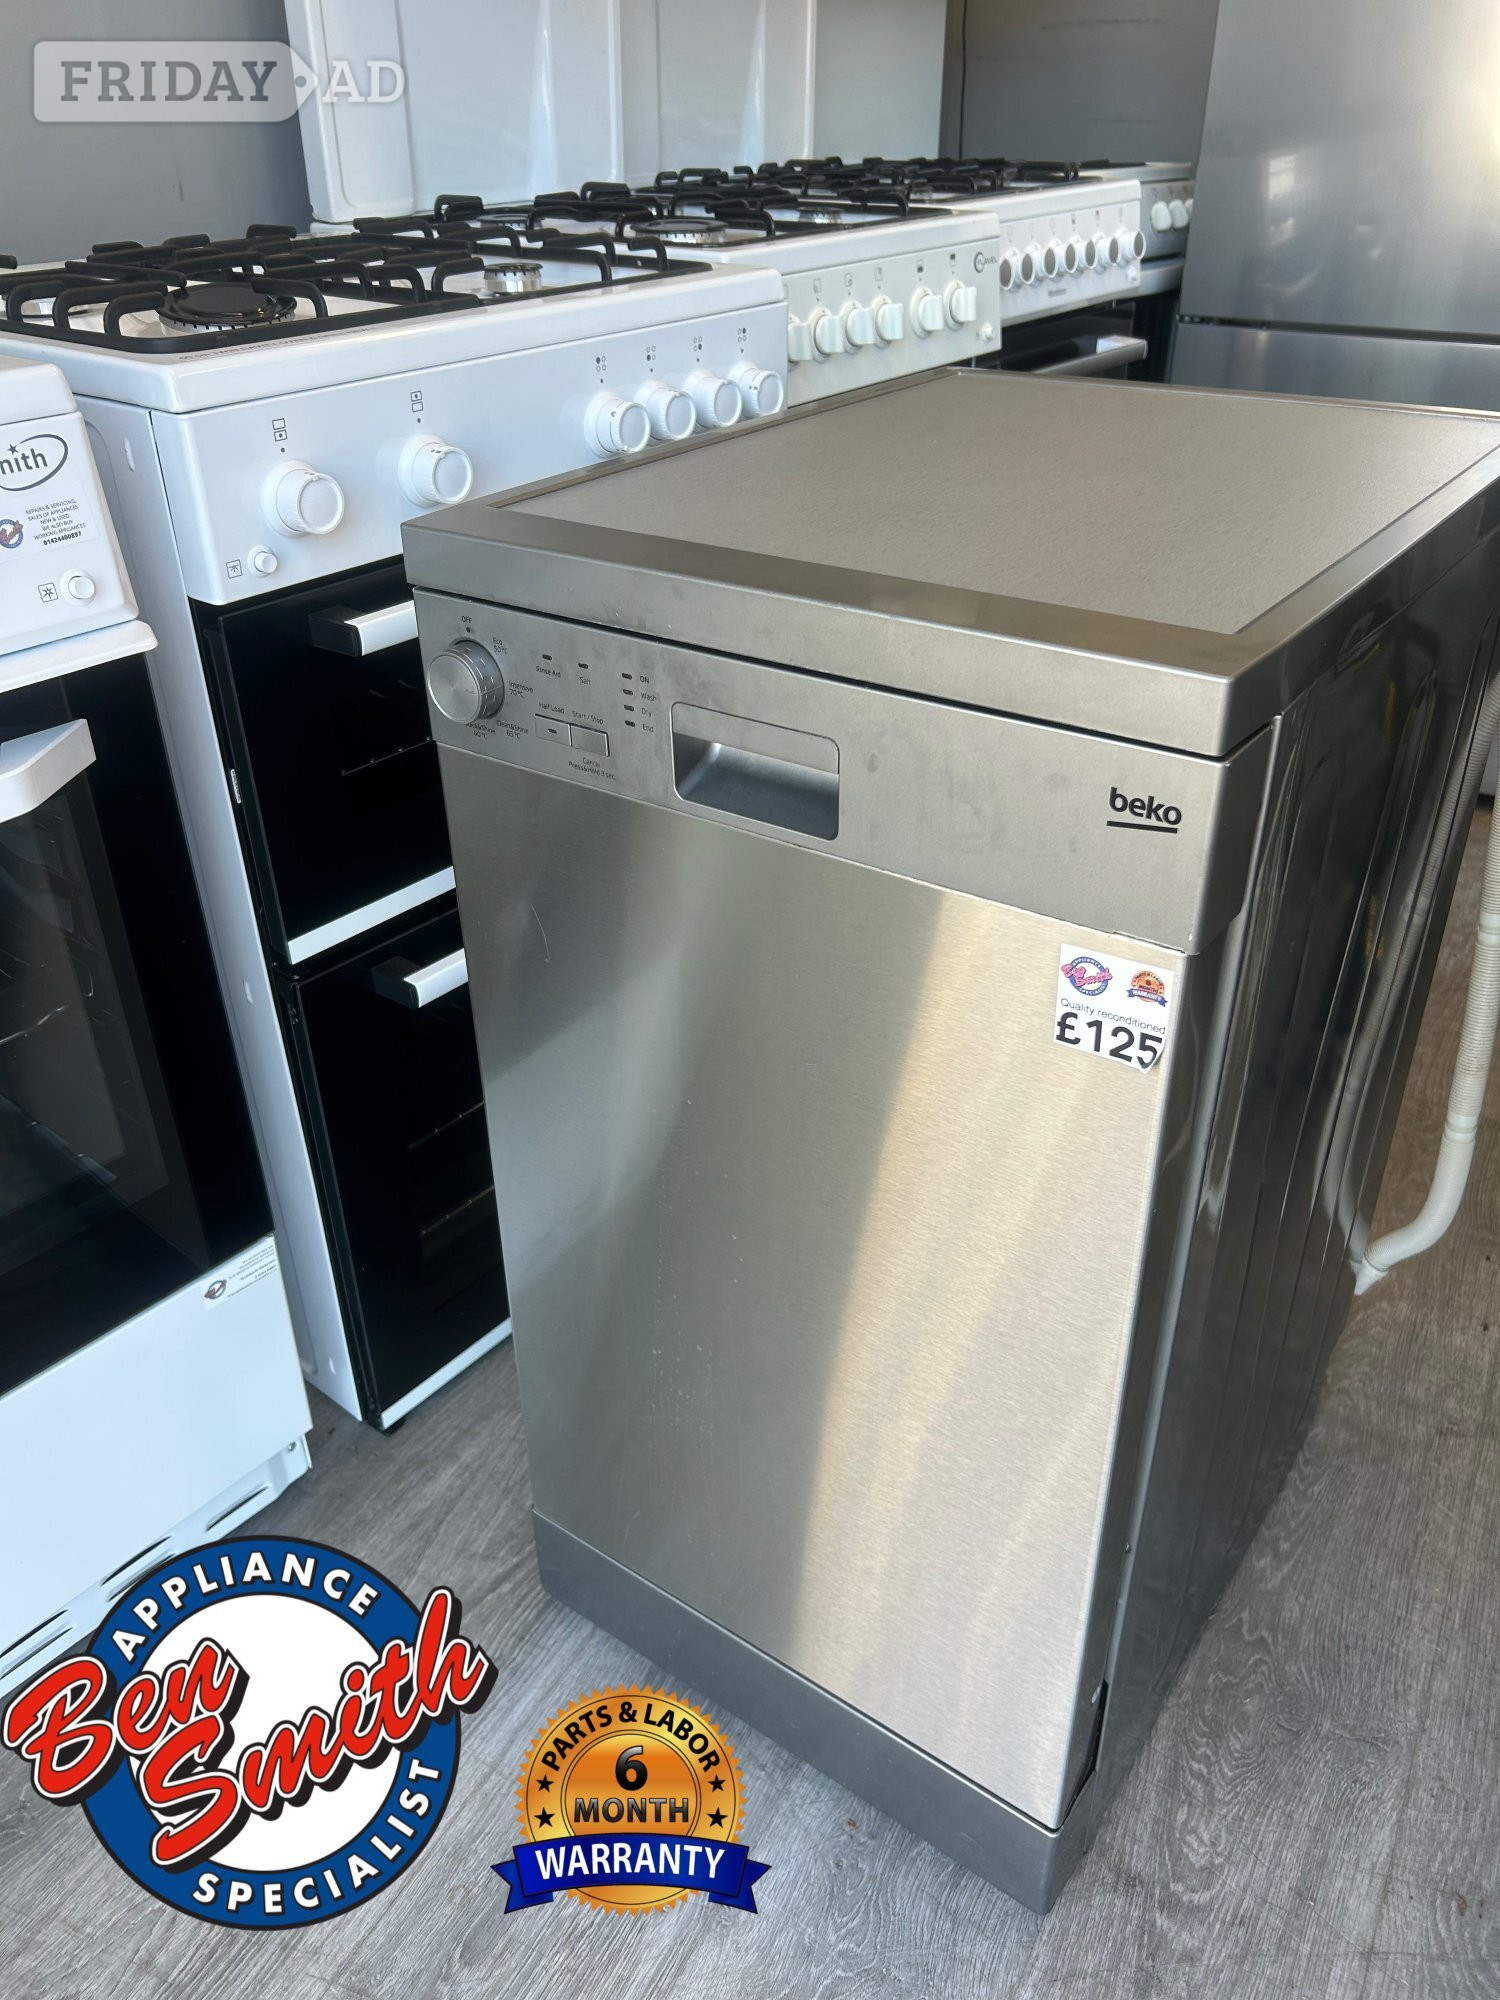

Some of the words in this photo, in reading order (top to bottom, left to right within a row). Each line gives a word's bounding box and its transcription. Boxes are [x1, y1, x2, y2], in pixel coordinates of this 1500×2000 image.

[25, 506, 46, 515] REPAIRS
[28, 513, 43, 521] SALES
[40, 517, 52, 525] NEW
[51, 521, 64, 529] ALSO
[33, 530, 58, 540] WORKING
[59, 522, 87, 533] APPLIANCES
[461, 615, 472, 623] OFF
[492, 637, 503, 646] Eco
[579, 676, 592, 686] Salt
[640, 675, 650, 684] ON
[641, 692, 657, 702] Wash
[538, 701, 550, 710] Half
[551, 704, 565, 714] Load
[641, 707, 652, 717] Dry
[572, 710, 586, 720] Start
[590, 715, 604, 725] Stop
[496, 719, 529, 734] Clean&Shine
[642, 723, 654, 732] End
[1109, 787, 1182, 825] beko
[1060, 998, 1095, 1016] Quality
[1097, 1010, 1166, 1034] reconditioned
[1056, 1011, 1163, 1069] £125
